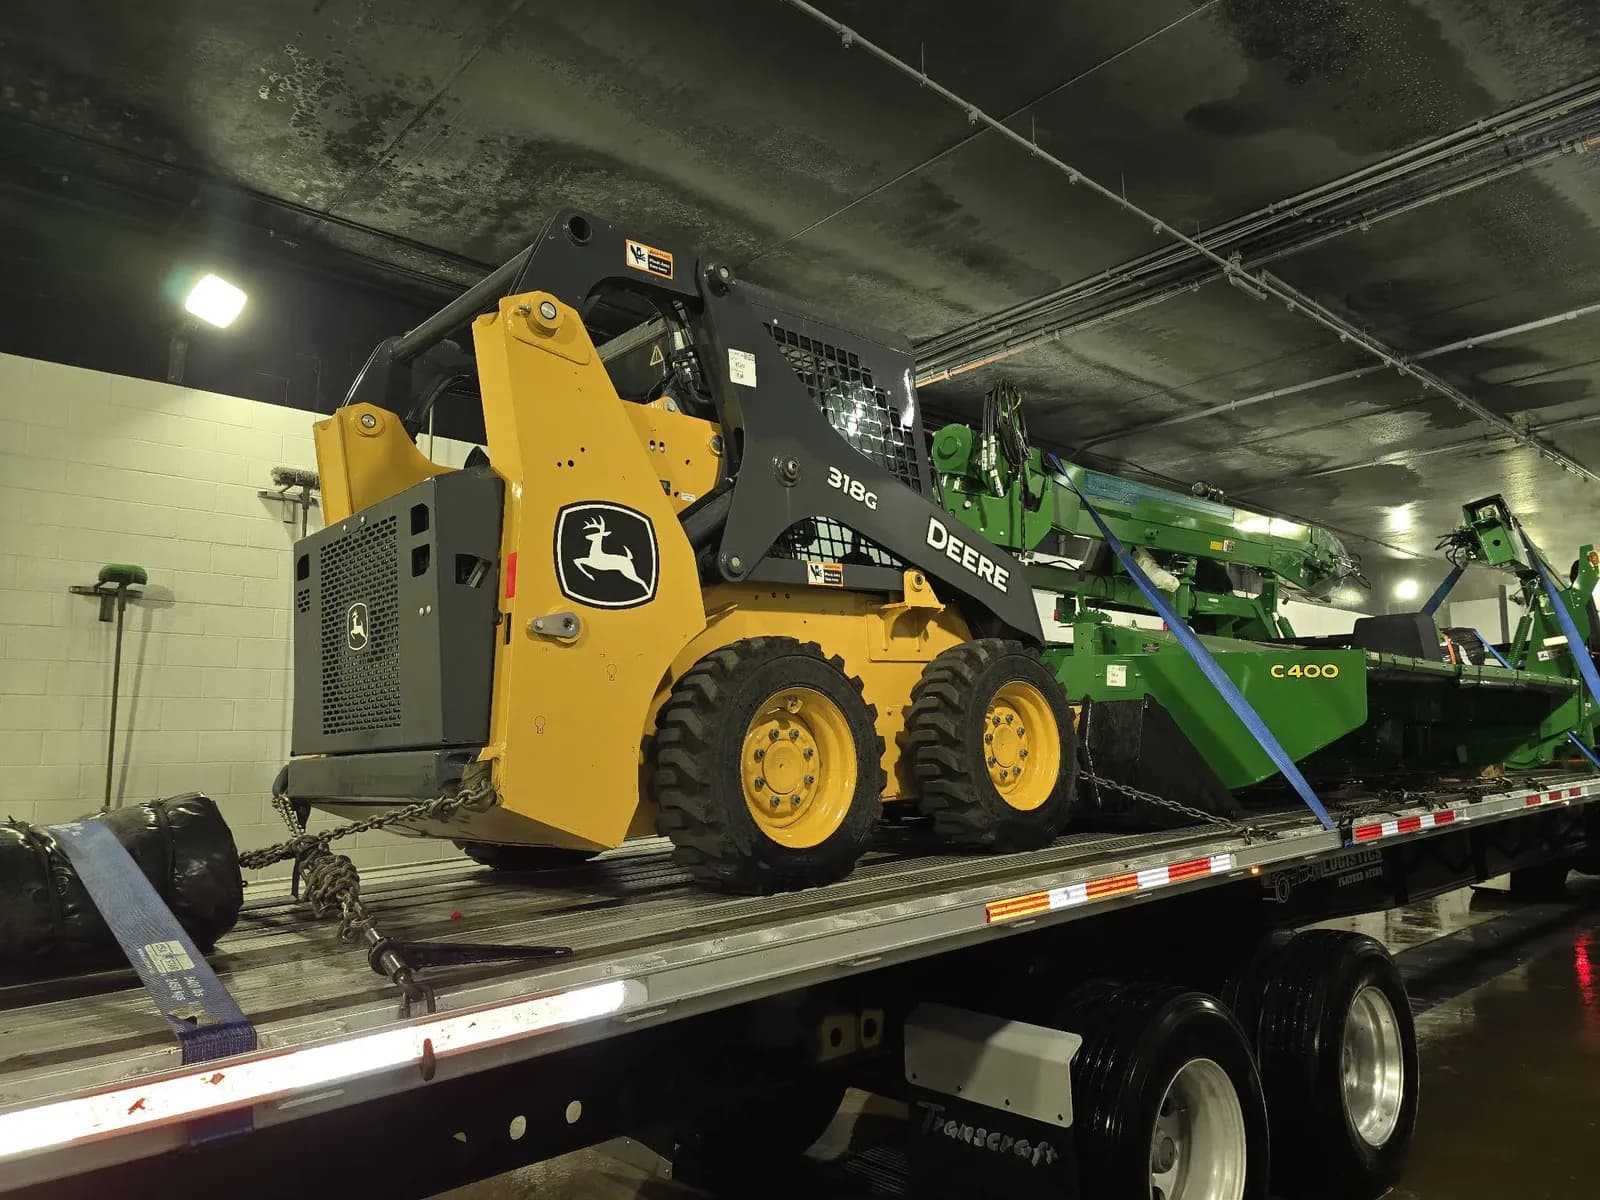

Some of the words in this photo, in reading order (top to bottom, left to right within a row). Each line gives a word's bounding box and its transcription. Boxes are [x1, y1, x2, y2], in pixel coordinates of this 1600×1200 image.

[827, 466, 878, 510] 318G
[926, 517, 1011, 593] DEERE
[1270, 664, 1340, 679] C400
